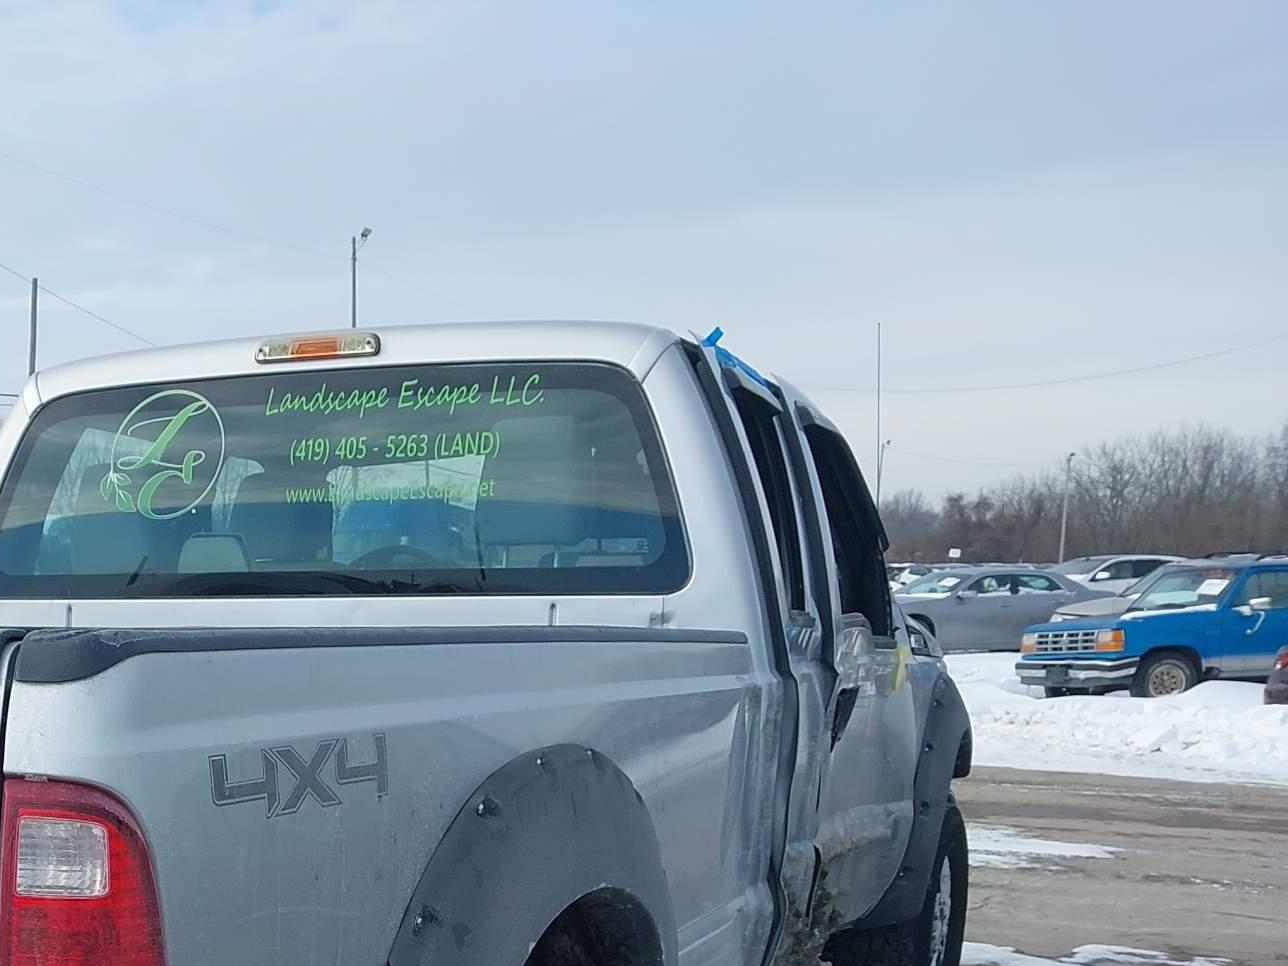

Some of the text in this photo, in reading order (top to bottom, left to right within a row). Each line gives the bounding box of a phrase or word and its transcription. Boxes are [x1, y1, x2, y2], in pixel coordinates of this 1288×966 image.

[265, 373, 545, 418] Landscape Escape LLC.
[289, 438, 330, 465] (419)
[334, 436, 367, 459] 405
[384, 434, 429, 458] 5263
[434, 431, 501, 459] (LAND)
